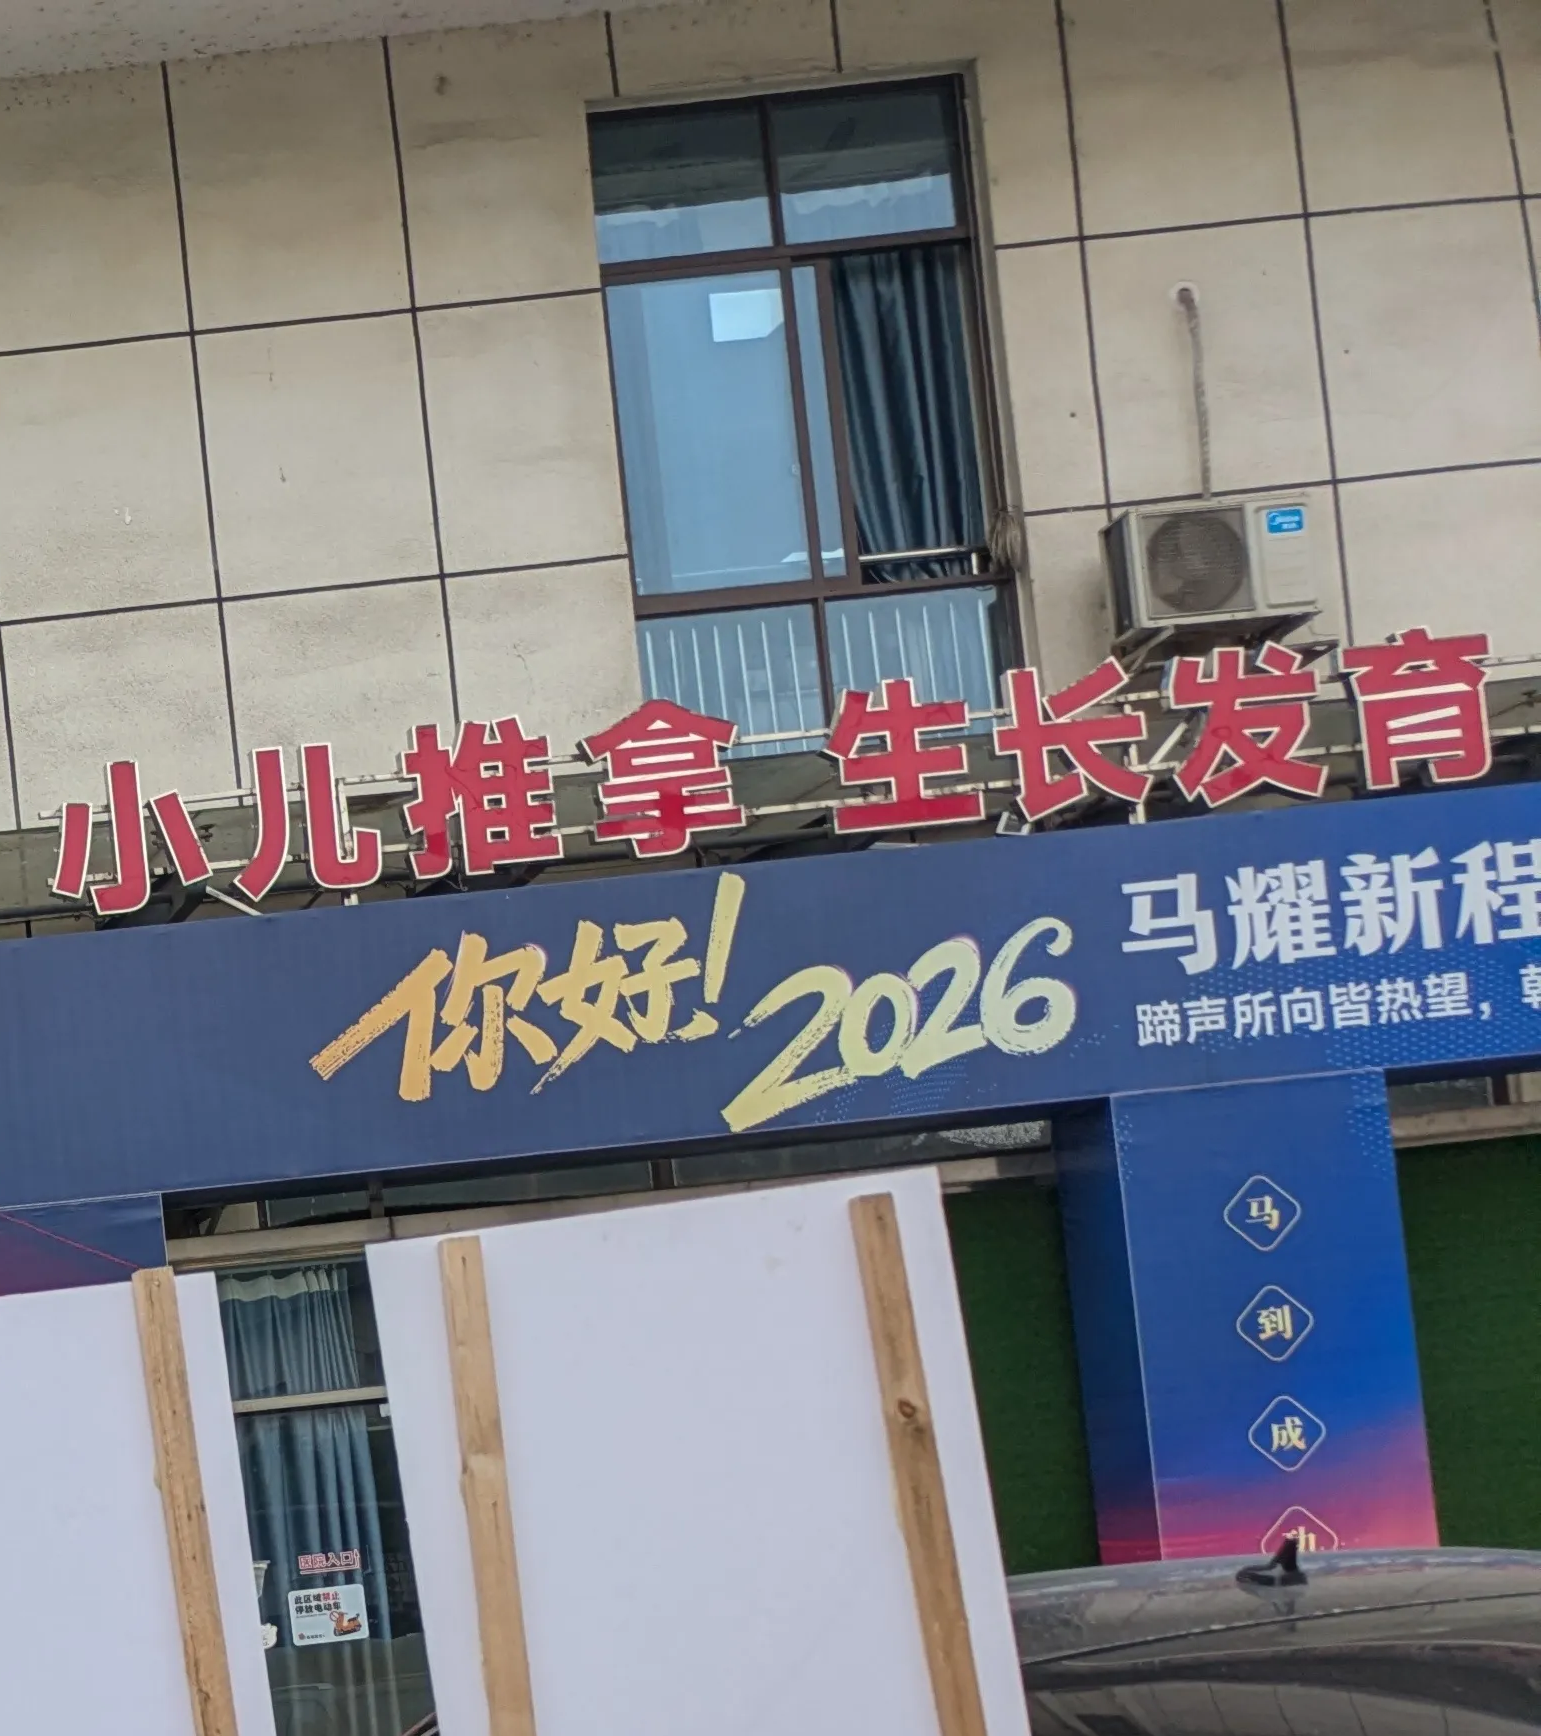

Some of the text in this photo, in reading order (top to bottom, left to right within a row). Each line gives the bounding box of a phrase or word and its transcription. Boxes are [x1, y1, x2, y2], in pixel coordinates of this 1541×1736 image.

[51, 626, 1493, 916] 小儿推拿 生长发育
[1121, 839, 1541, 976] 马耀新程
[728, 916, 1077, 1133] 2026
[298, 1551, 354, 1569] 医院入口
